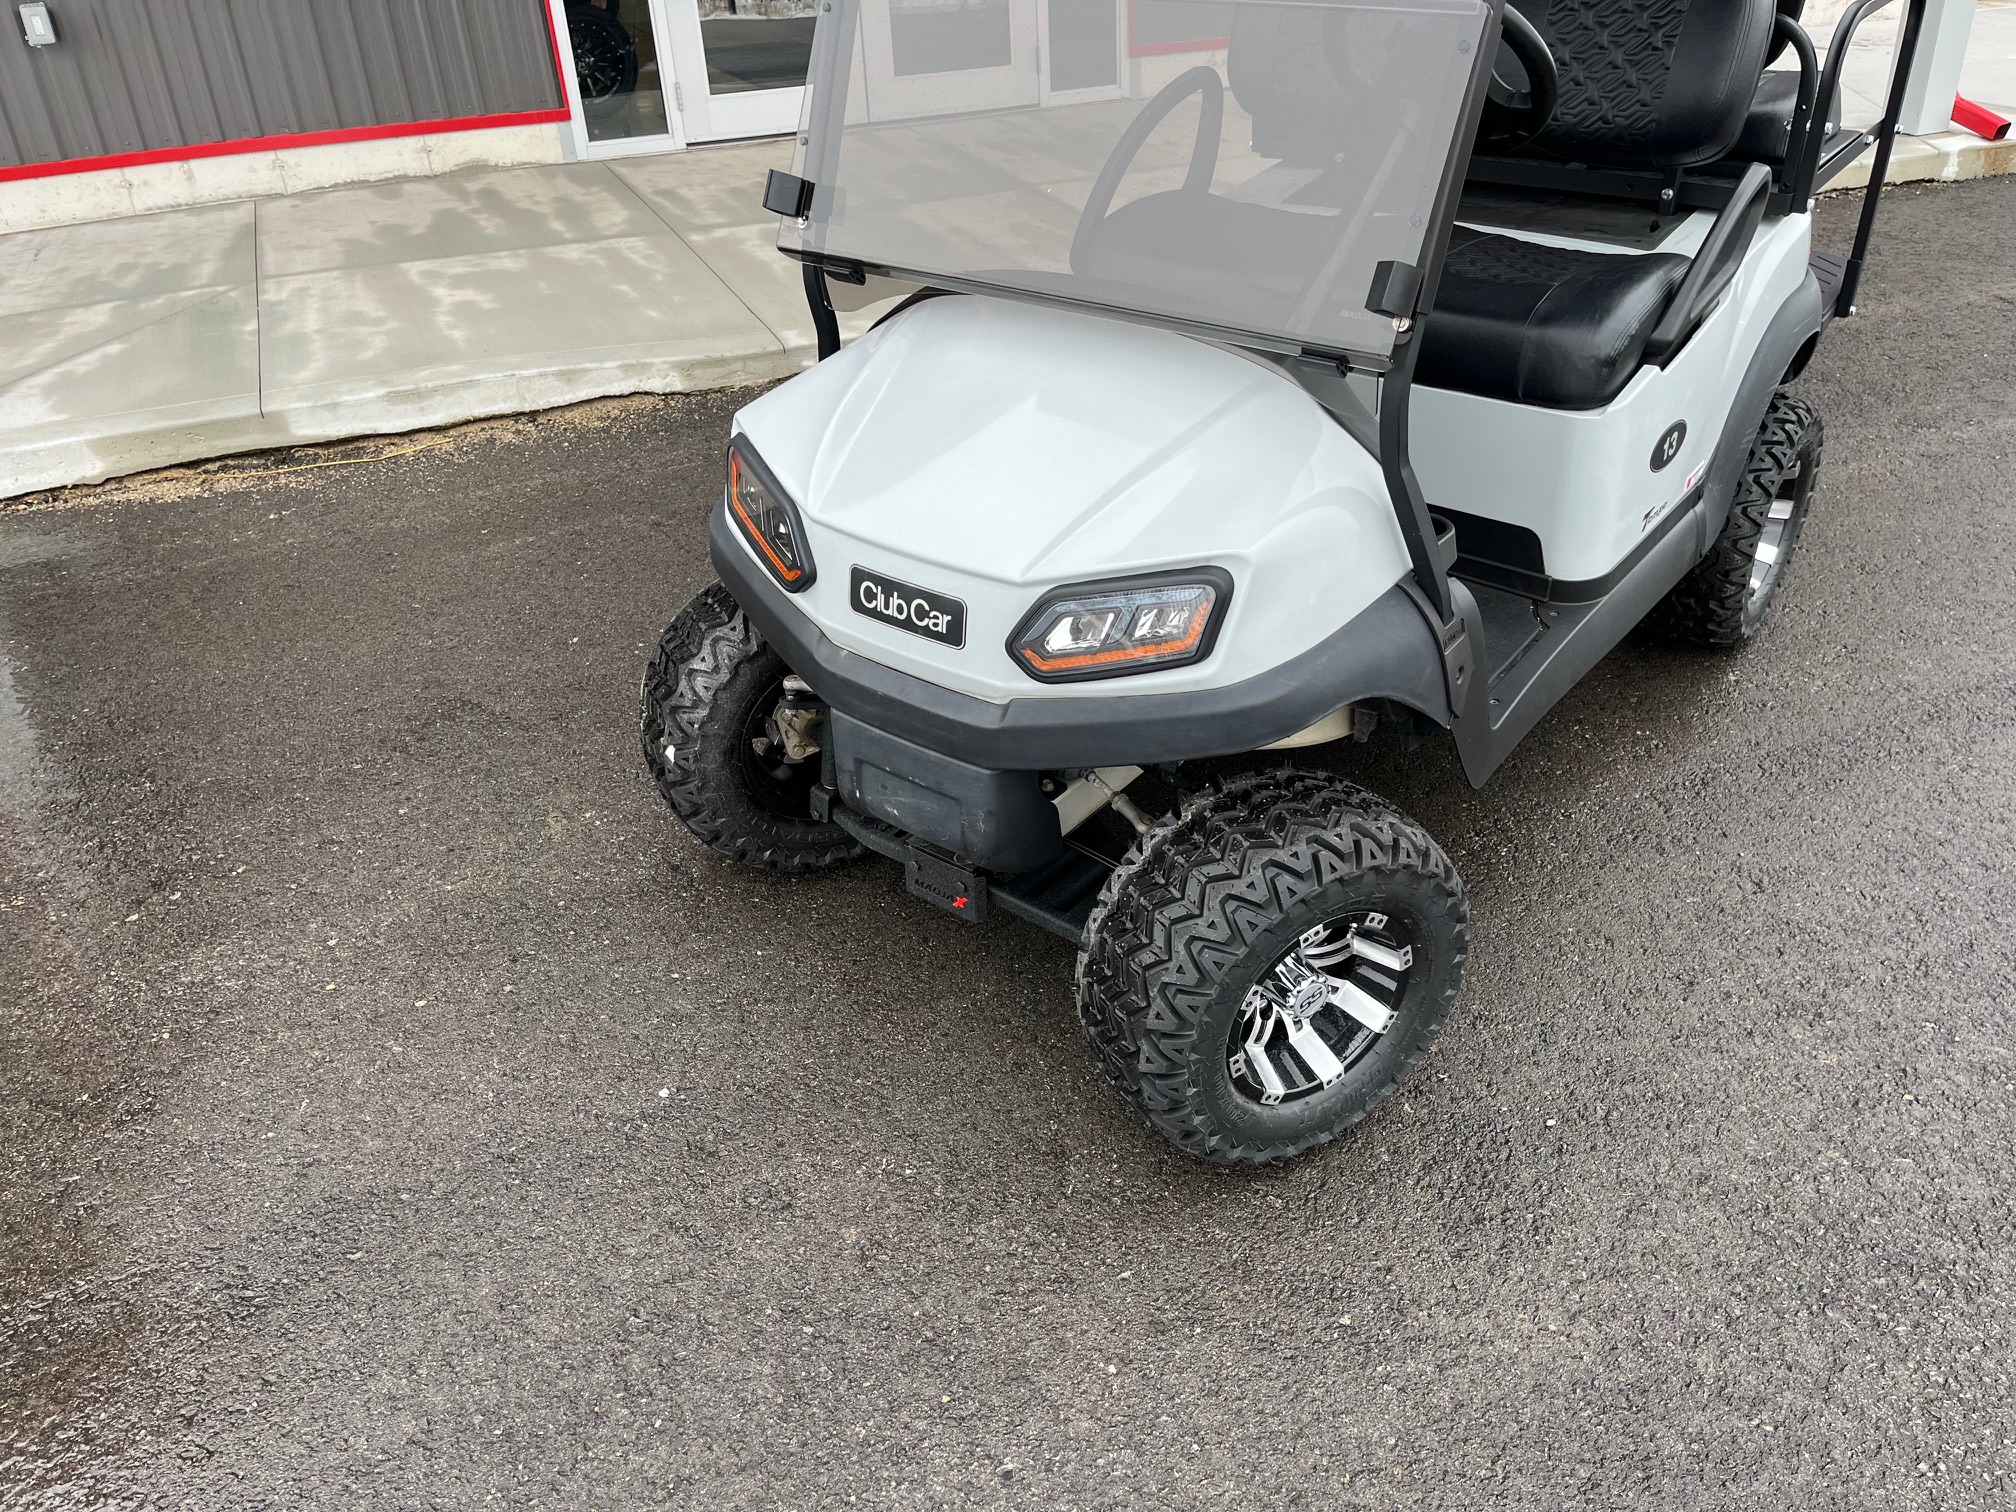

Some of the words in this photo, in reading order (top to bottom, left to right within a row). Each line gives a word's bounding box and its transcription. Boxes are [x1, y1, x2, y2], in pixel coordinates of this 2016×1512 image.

[1663, 431, 1679, 461] 13
[859, 580, 908, 620] Club
[910, 598, 952, 634] Car
